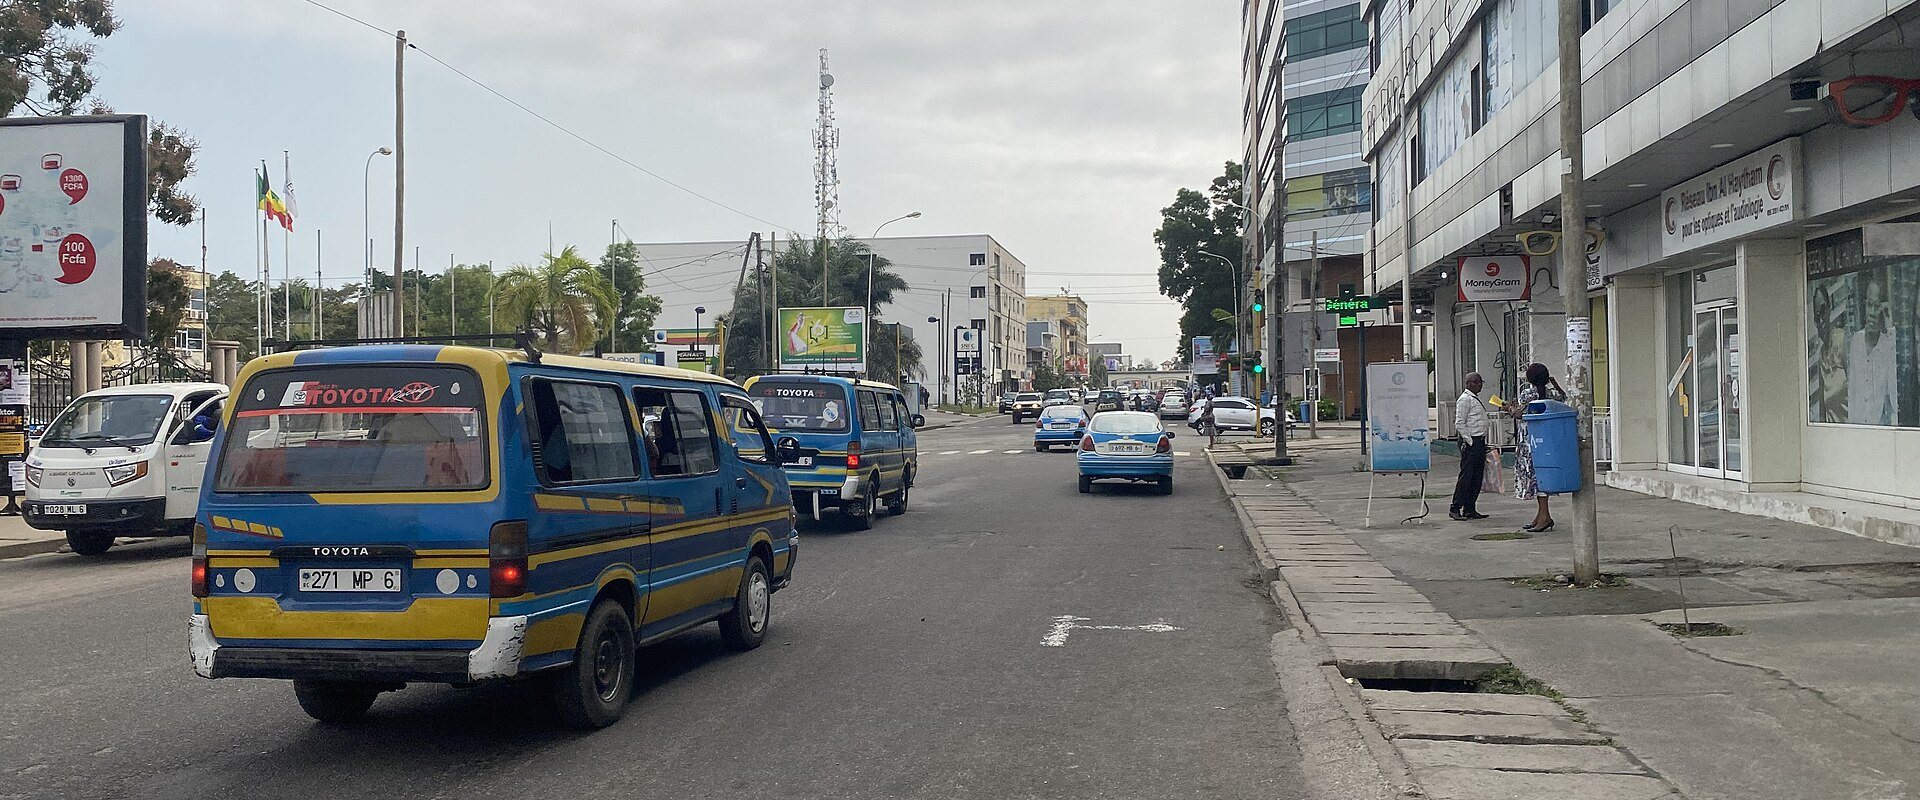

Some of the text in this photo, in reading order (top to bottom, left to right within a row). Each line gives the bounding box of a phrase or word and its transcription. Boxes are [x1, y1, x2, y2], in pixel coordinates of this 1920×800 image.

[1680, 188, 1705, 212] Réseau
[1682, 222, 1693, 242] pour
[1701, 211, 1724, 235] optiques
[64, 242, 84, 252] 100
[62, 254, 86, 264] Fcfa
[1465, 279, 1520, 288] MoneyGram
[306, 388, 396, 405] TOYOTA
[312, 548, 368, 556] TOYOTA
[312, 571, 394, 589] 271 MP 6
